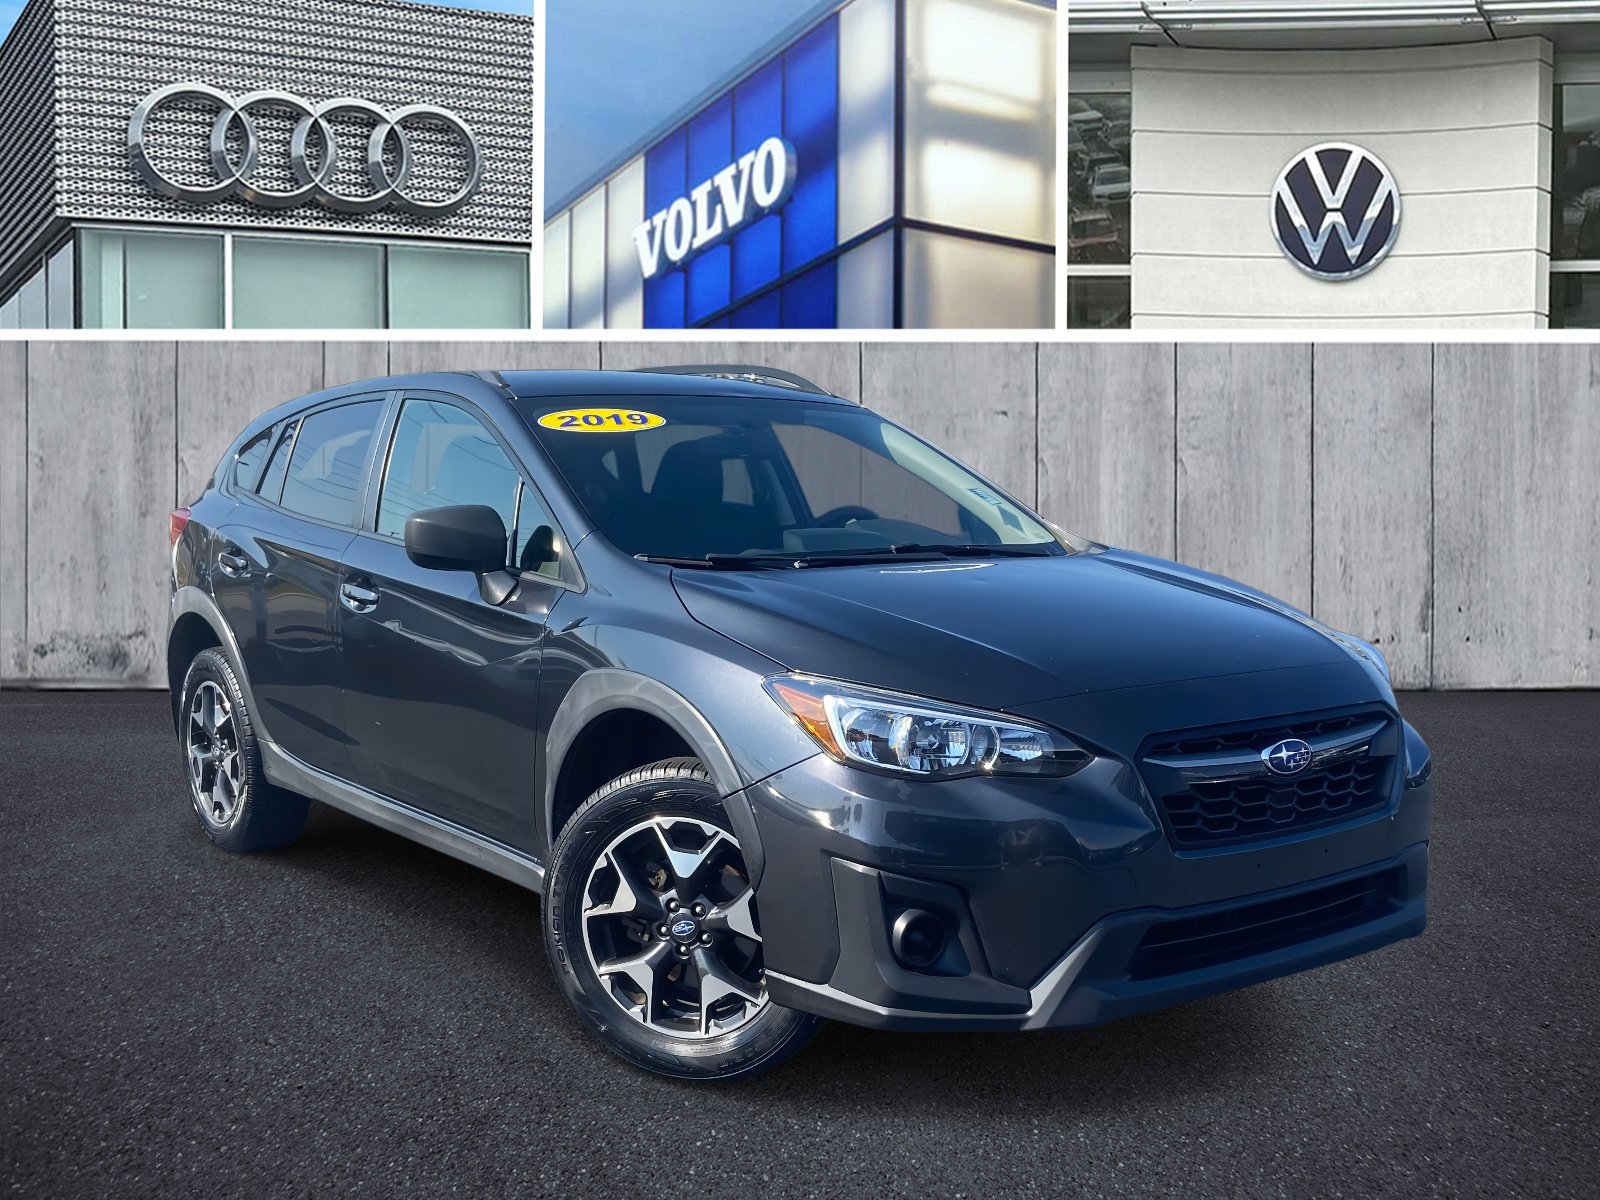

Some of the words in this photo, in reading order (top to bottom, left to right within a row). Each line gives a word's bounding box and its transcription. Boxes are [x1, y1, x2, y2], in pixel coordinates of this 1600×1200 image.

[632, 136, 788, 279] VOLVO
[1274, 147, 1393, 267] VW
[557, 413, 650, 428] 2019
